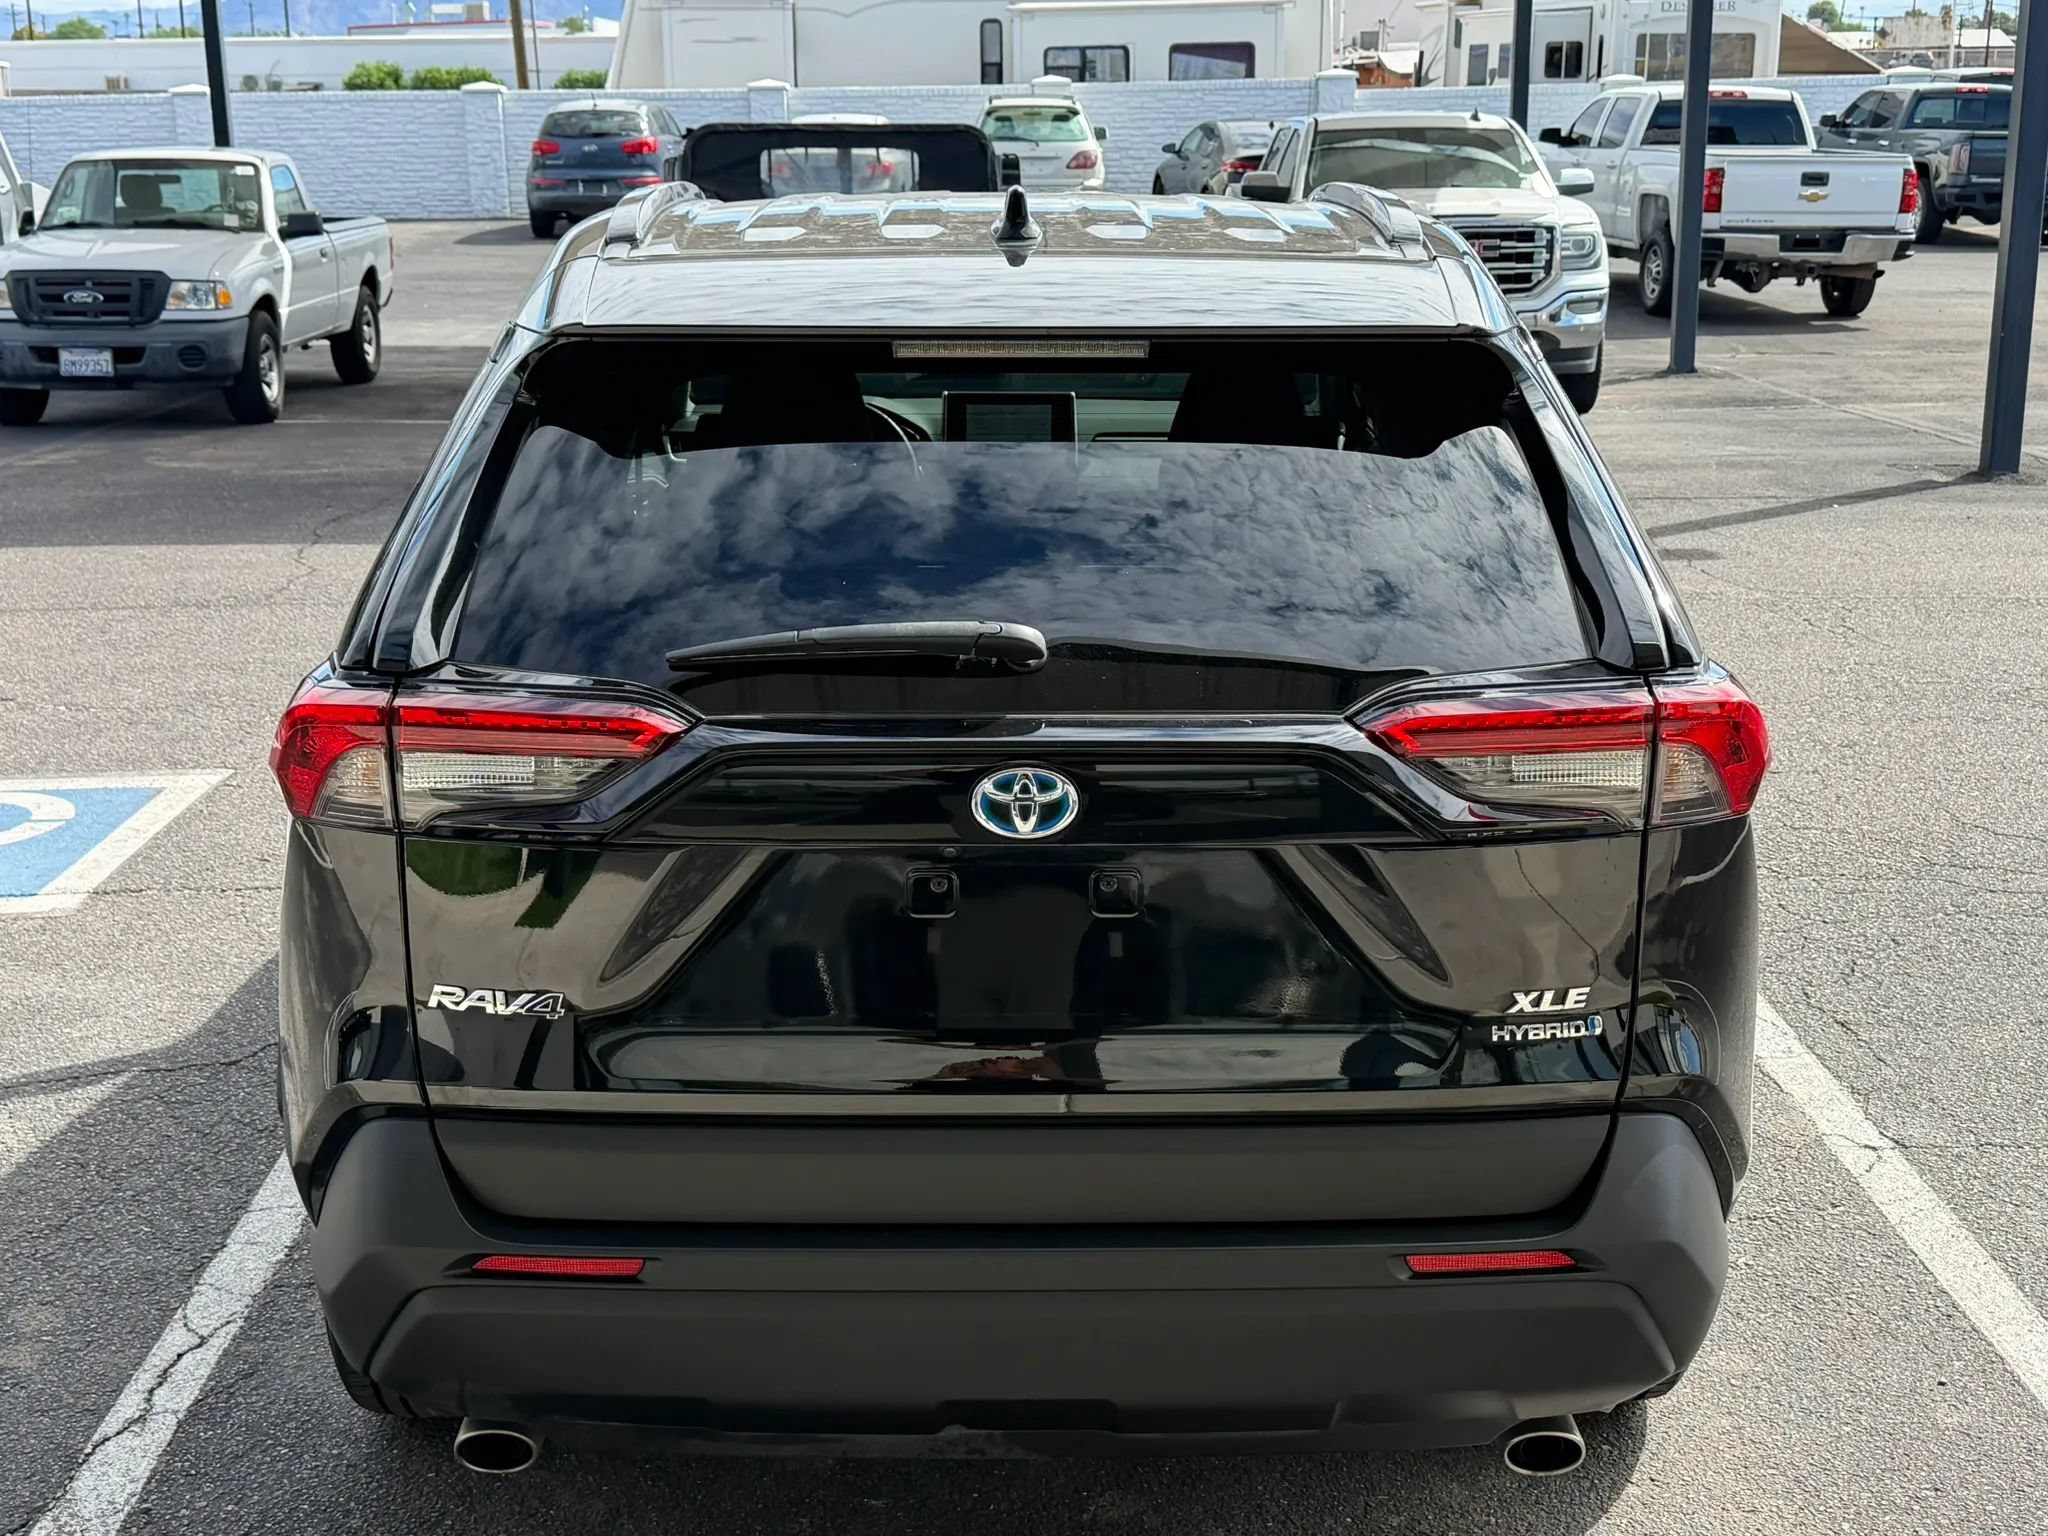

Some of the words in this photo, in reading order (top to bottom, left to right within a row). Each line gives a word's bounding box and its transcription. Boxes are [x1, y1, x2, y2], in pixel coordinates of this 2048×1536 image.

[1661, 1, 1736, 13] DESER
[427, 983, 565, 1020] RAV4
[1504, 986, 1591, 1014] XLE
[1492, 1020, 1586, 1042] HYBRID
